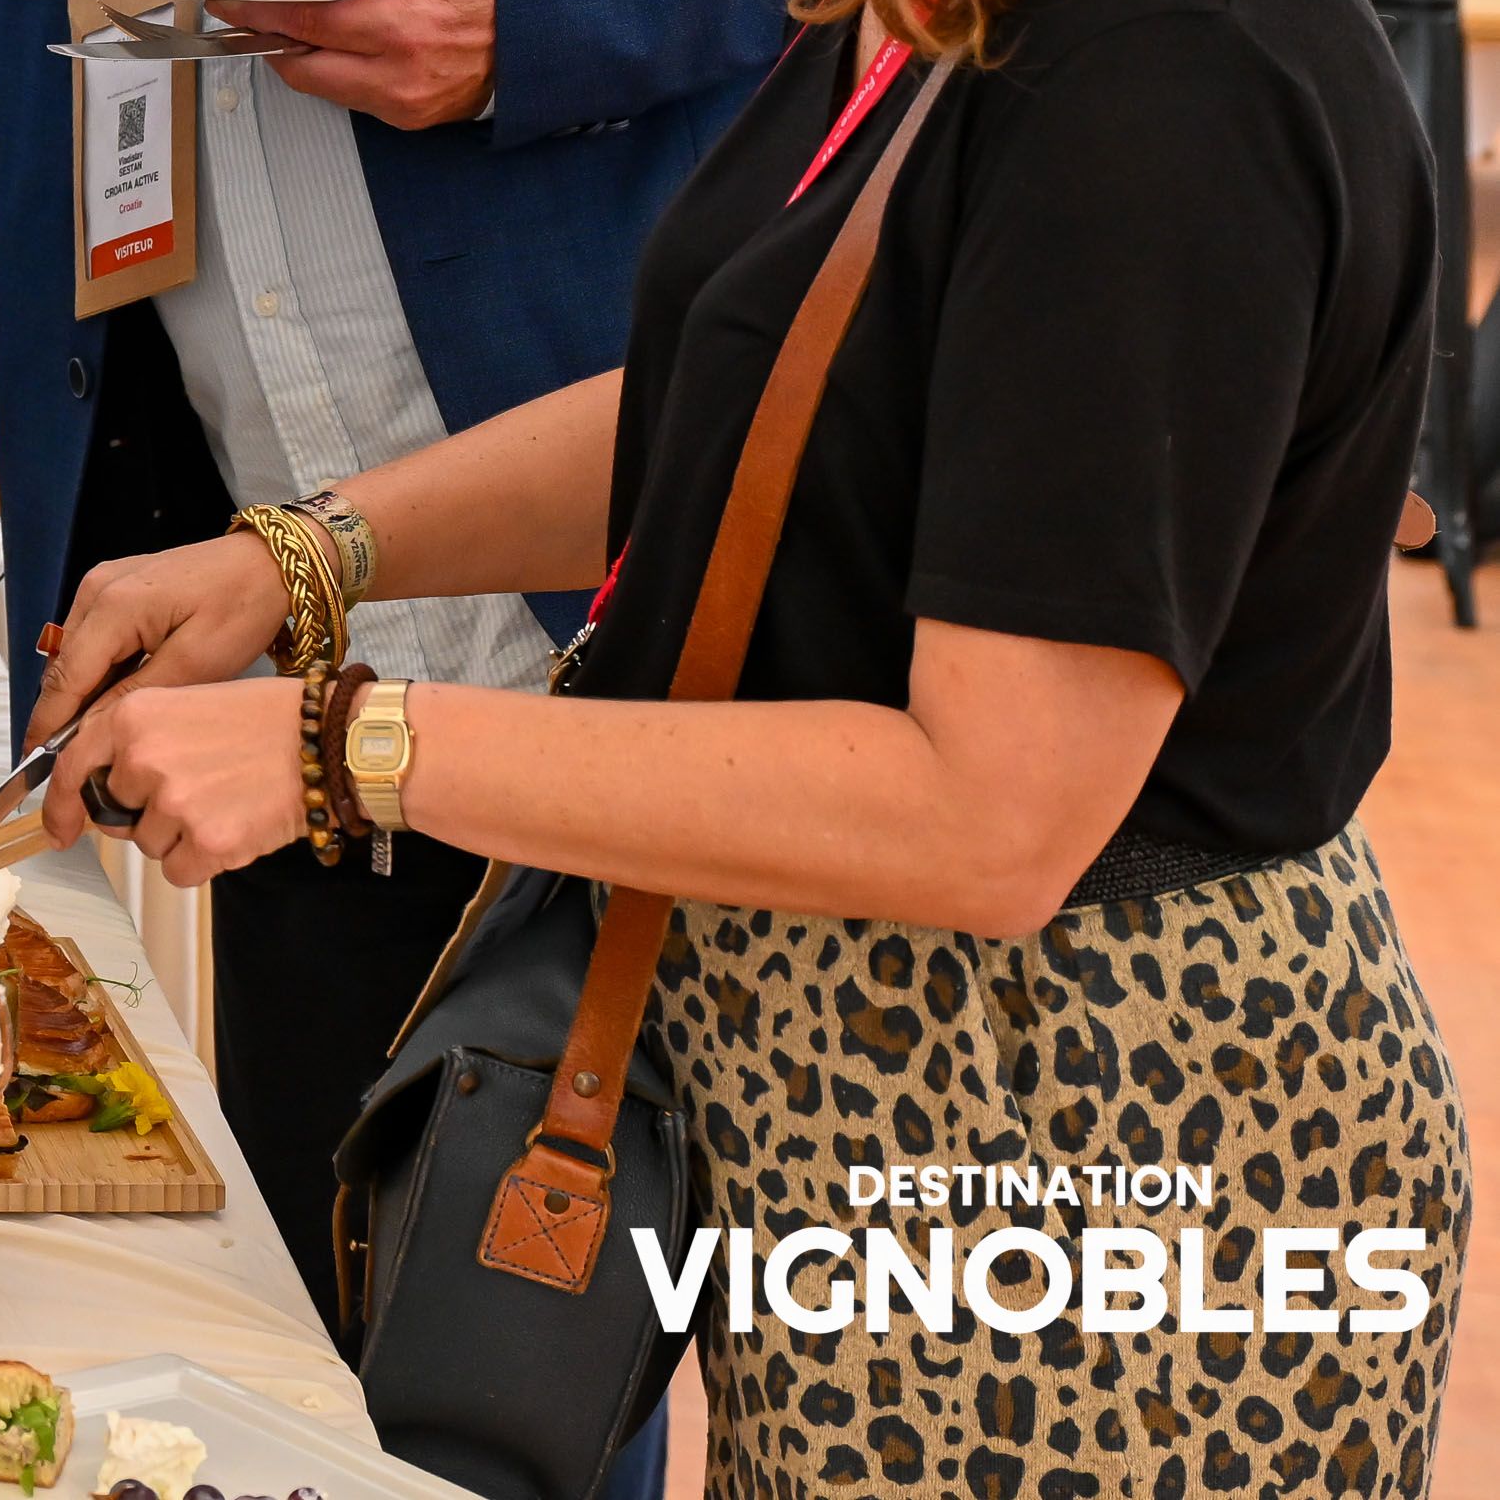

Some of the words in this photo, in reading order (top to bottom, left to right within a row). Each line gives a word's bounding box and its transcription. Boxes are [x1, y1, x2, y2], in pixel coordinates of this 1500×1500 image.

[104, 179, 133, 200] CROATIA
[134, 171, 160, 190] ACTIVE
[118, 198, 143, 215] Croatie
[114, 237, 154, 261] VISITEUR
